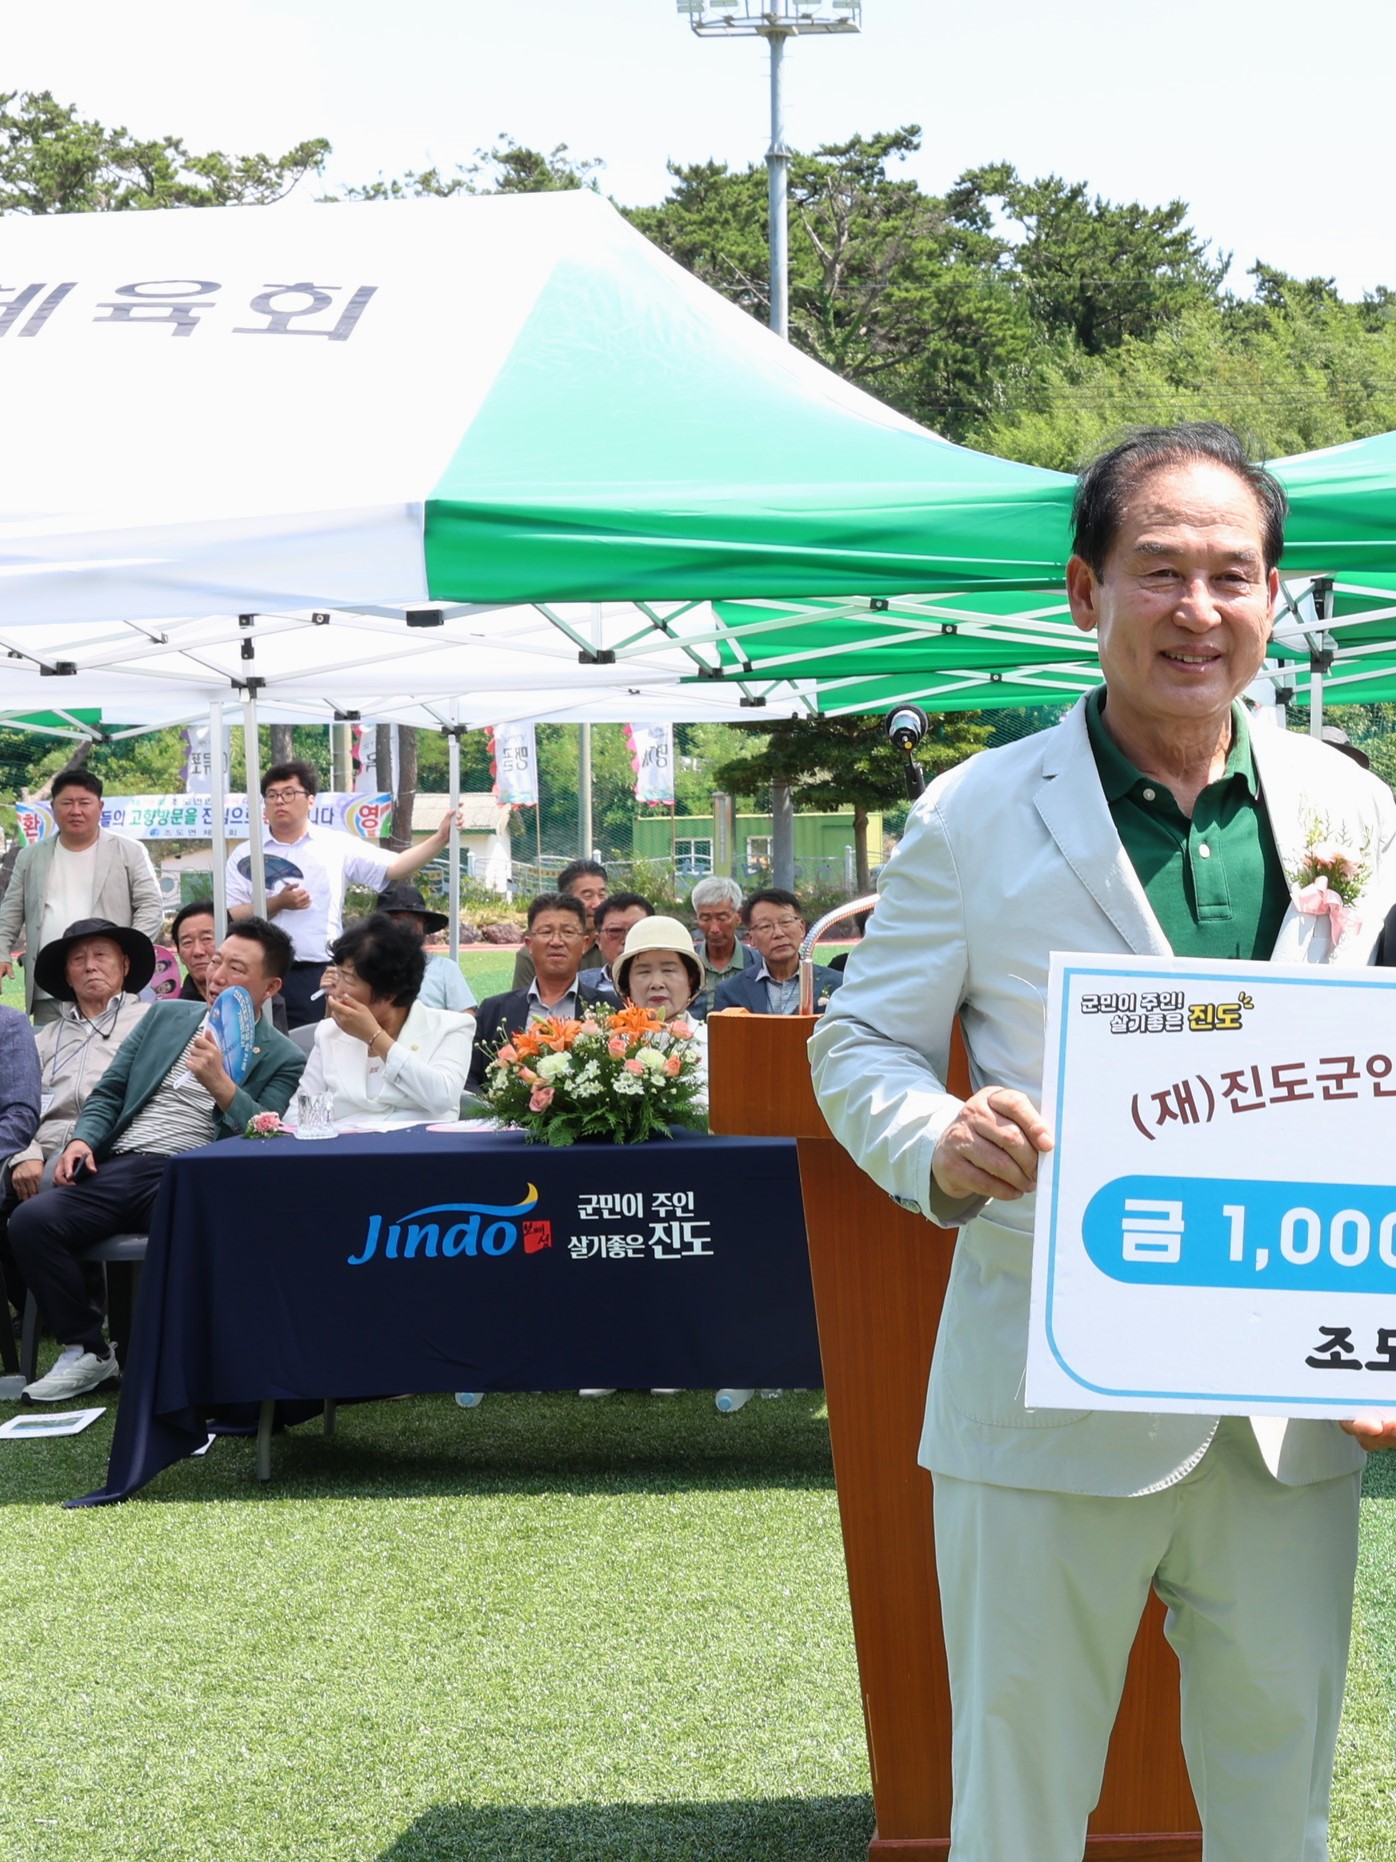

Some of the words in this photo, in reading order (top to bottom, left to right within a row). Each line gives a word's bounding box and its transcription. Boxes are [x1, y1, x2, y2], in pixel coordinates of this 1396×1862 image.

[23, 813, 40, 837] 환
[129, 807, 198, 827] 고향방문을
[359, 804, 379, 829] 영
[1081, 993, 1136, 1013] 군민이
[1140, 991, 1184, 1012] 주인!
[1110, 1013, 1184, 1034] 살기좋은
[1188, 1003, 1243, 1032] 진도
[577, 1192, 643, 1220] 군민이
[652, 1191, 694, 1218] 주인
[347, 1214, 517, 1265] Jindo
[567, 1234, 645, 1259] 살기좋은
[648, 1221, 715, 1260] 진도
[1120, 1196, 1186, 1265] 금
